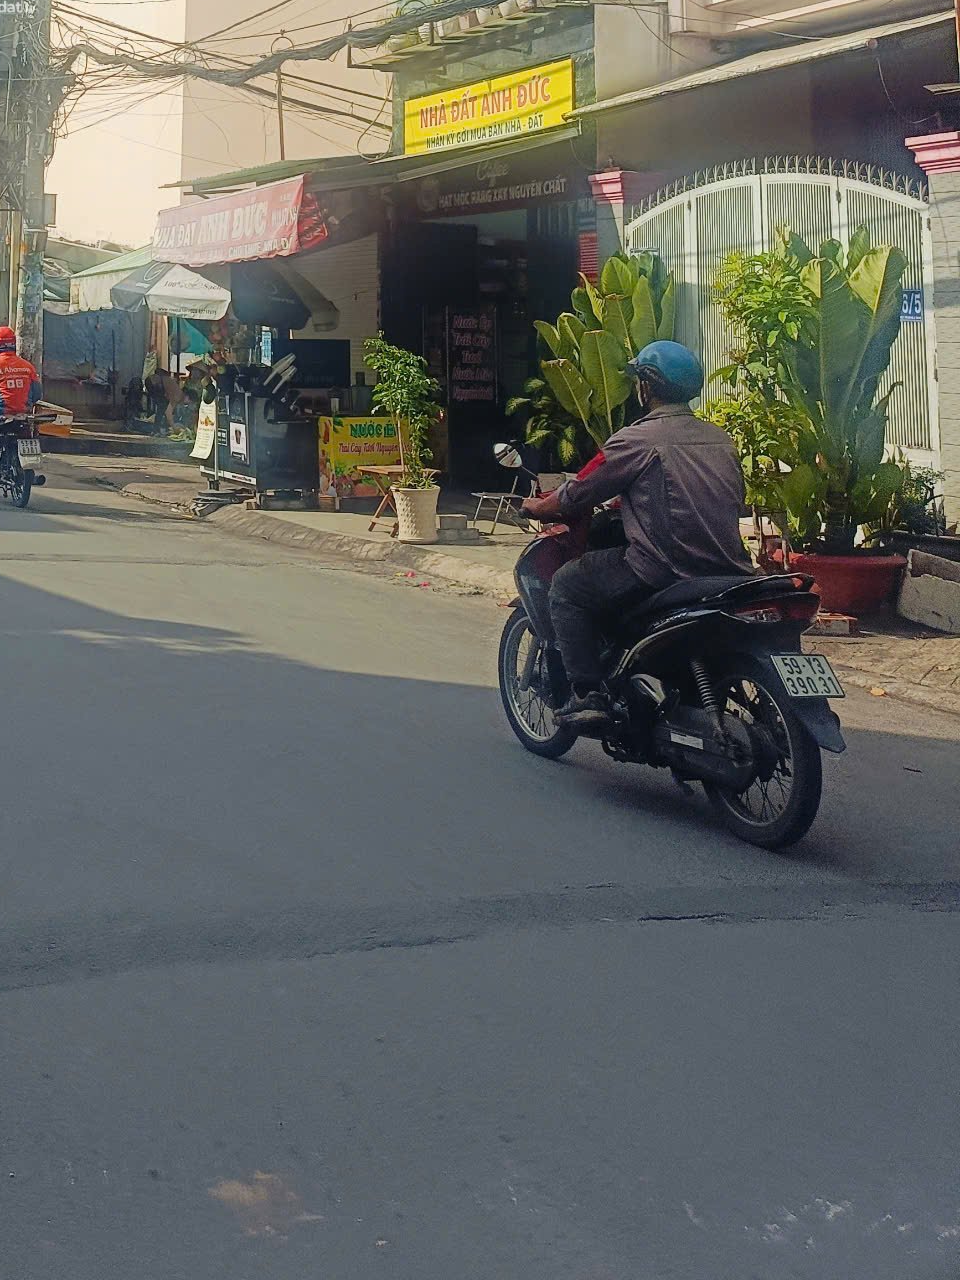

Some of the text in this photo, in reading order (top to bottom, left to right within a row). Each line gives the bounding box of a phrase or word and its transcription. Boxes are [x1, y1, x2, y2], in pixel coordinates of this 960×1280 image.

[420, 75, 551, 129] NHÀ ĐẤT ANH ĐỨC
[470, 127, 487, 141] MUA
[488, 122, 503, 138] BÁN
[505, 117, 522, 133] NHÀ
[528, 112, 544, 129] ĐẤT
[543, 174, 567, 194] CHẤT
[198, 209, 230, 244] ANH
[350, 420, 383, 438] NƯỚC
[786, 676, 840, 695] 390.31
